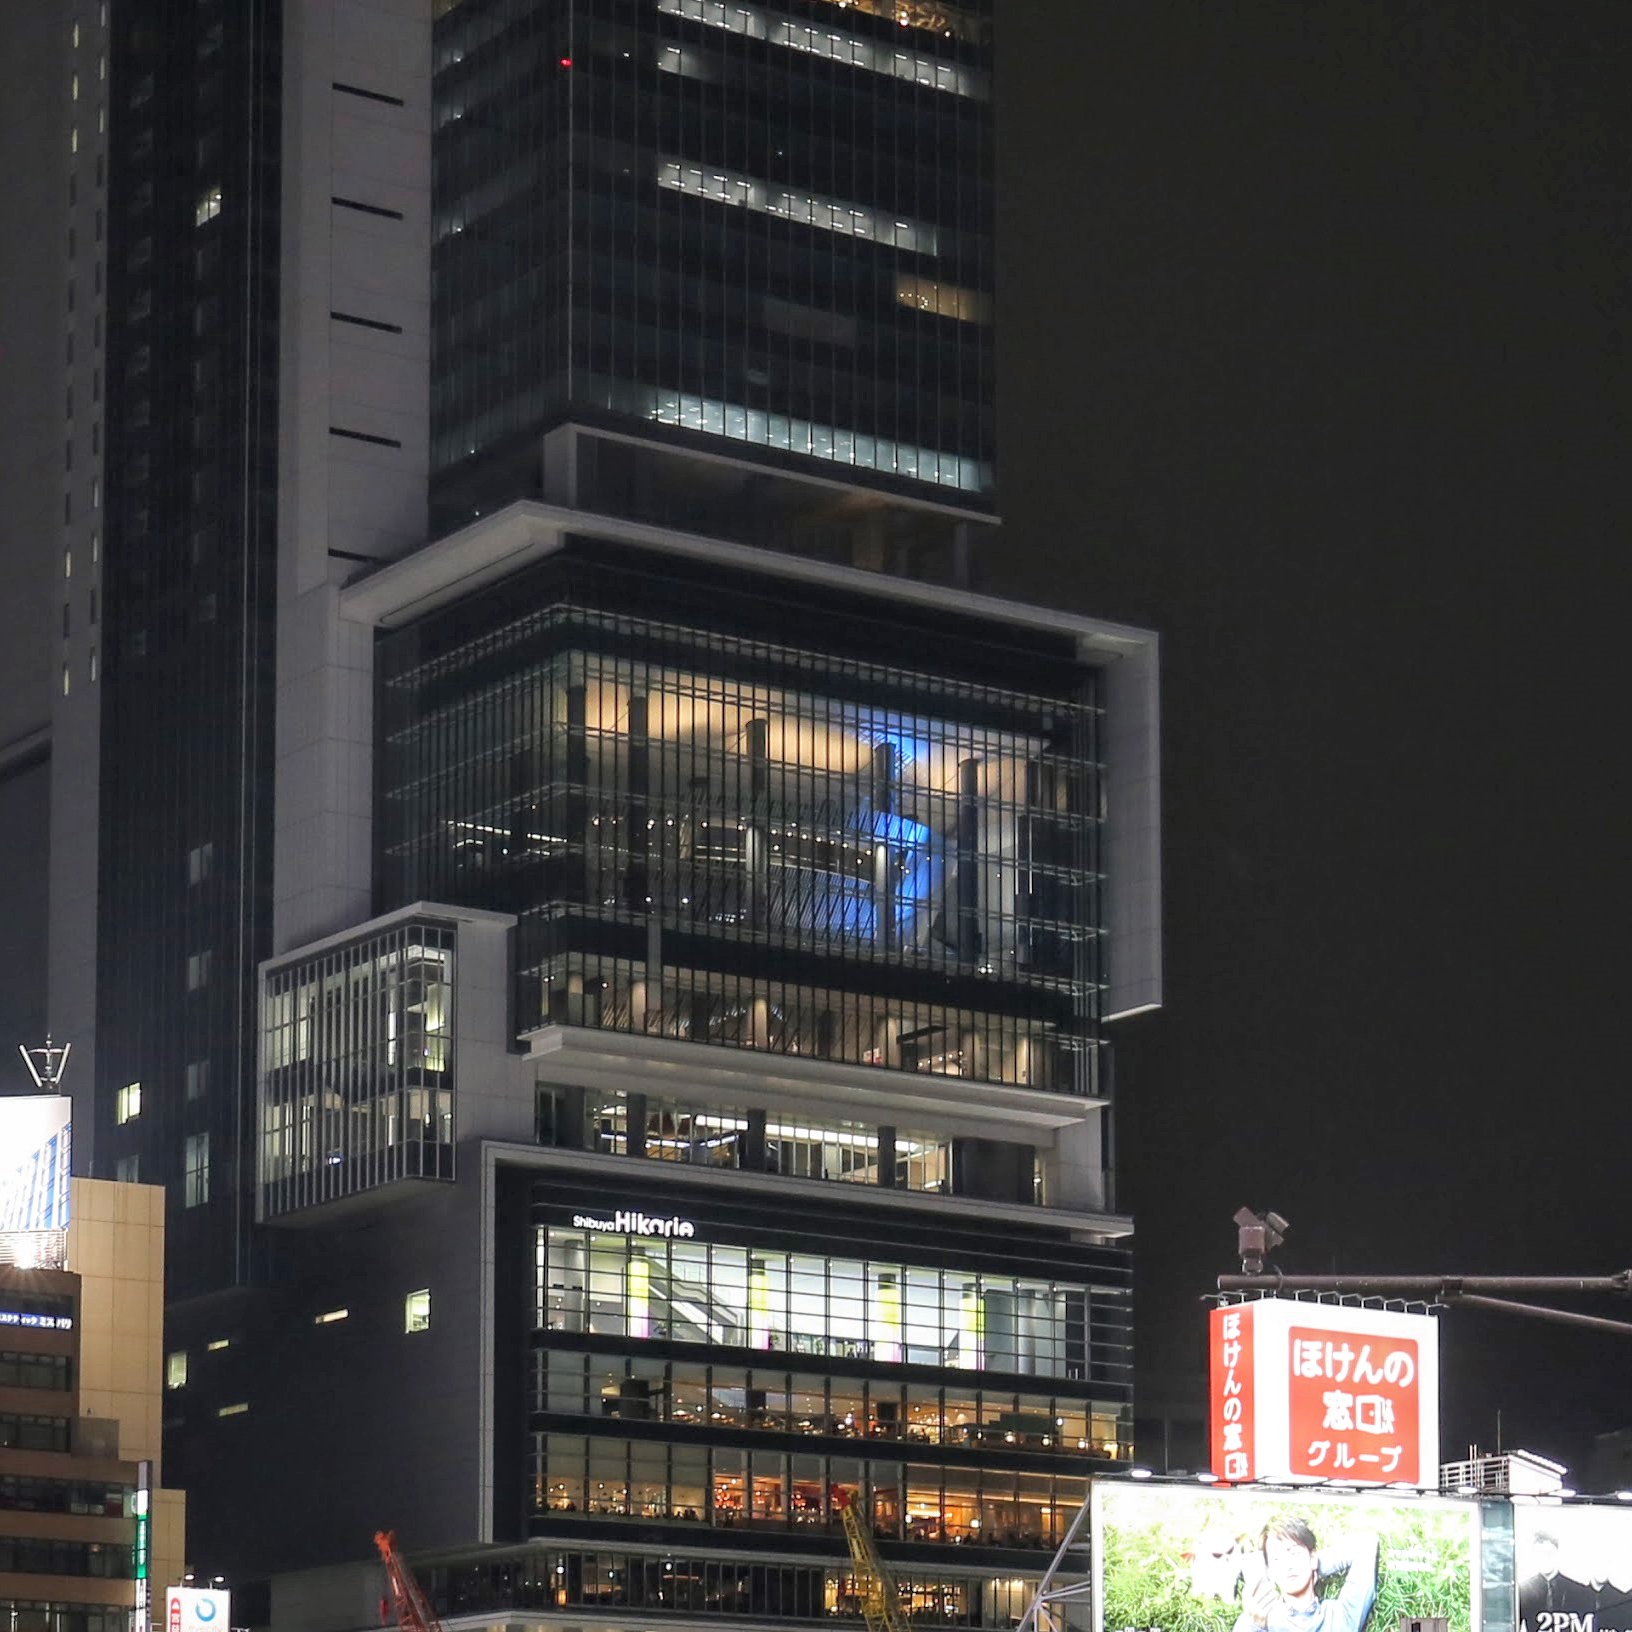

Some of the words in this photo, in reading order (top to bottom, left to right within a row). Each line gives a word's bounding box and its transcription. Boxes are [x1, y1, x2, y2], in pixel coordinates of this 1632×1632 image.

[572, 1214, 615, 1232] Shibuya
[615, 1210, 695, 1238] Hikarie
[1293, 1339, 1415, 1388] ほけんの
[1307, 1439, 1403, 1473] グループ
